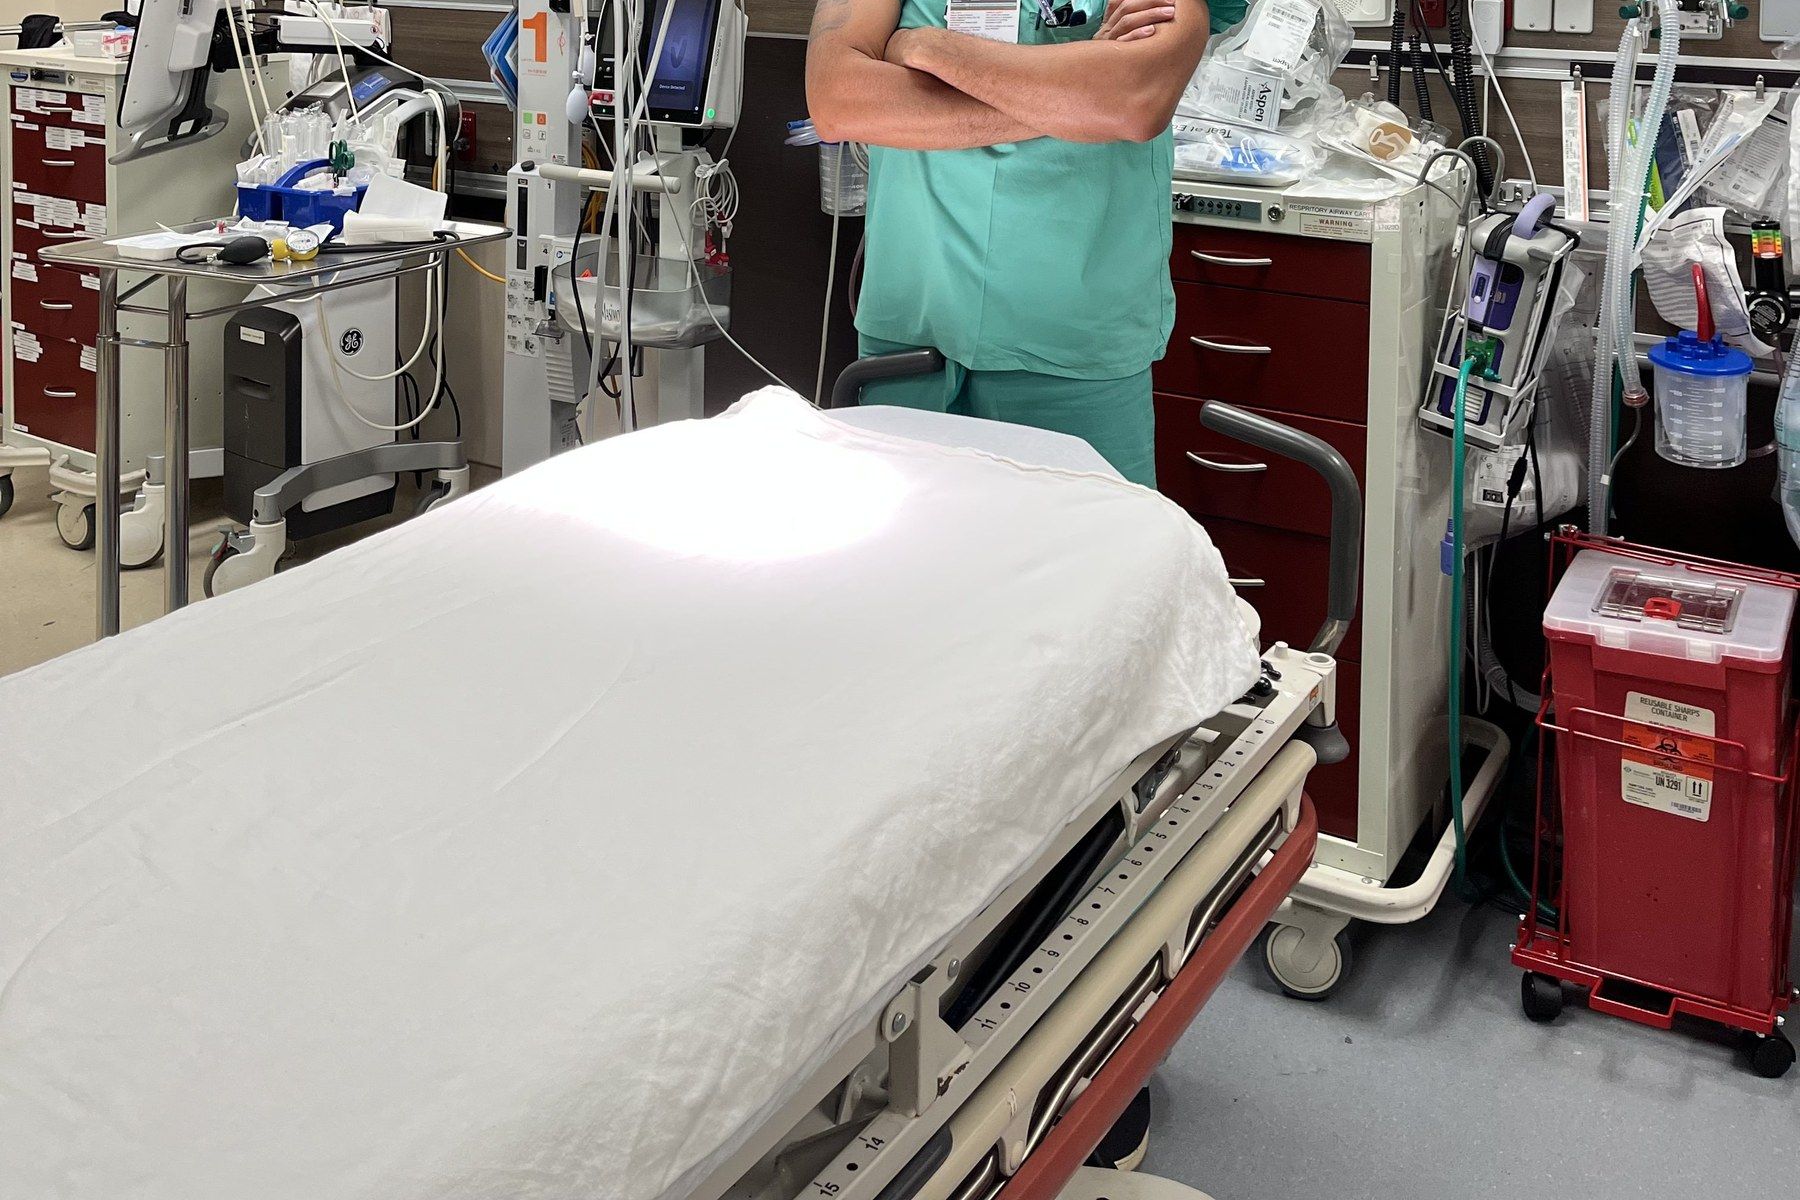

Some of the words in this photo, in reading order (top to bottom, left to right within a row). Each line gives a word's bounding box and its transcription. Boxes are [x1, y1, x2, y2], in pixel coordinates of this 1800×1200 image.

[522, 11, 547, 63] 1
[1254, 86, 1271, 122] Aspen
[1319, 219, 1353, 227] WARNING
[1640, 696, 1672, 710] REUSABLE
[1674, 704, 1700, 717] SHARPS
[1651, 707, 1688, 722] CONTAINER
[1655, 776, 1665, 787] UN
[1665, 779, 1681, 791] 3291
[1155, 832, 1167, 840] 5
[1104, 887, 1116, 895] 7
[1076, 918, 1089, 926] 8
[1047, 950, 1060, 958] 9
[1014, 981, 1031, 993] 10
[981, 1018, 997, 1030] 11
[865, 1136, 885, 1151] 14
[819, 1181, 840, 1197] 15
